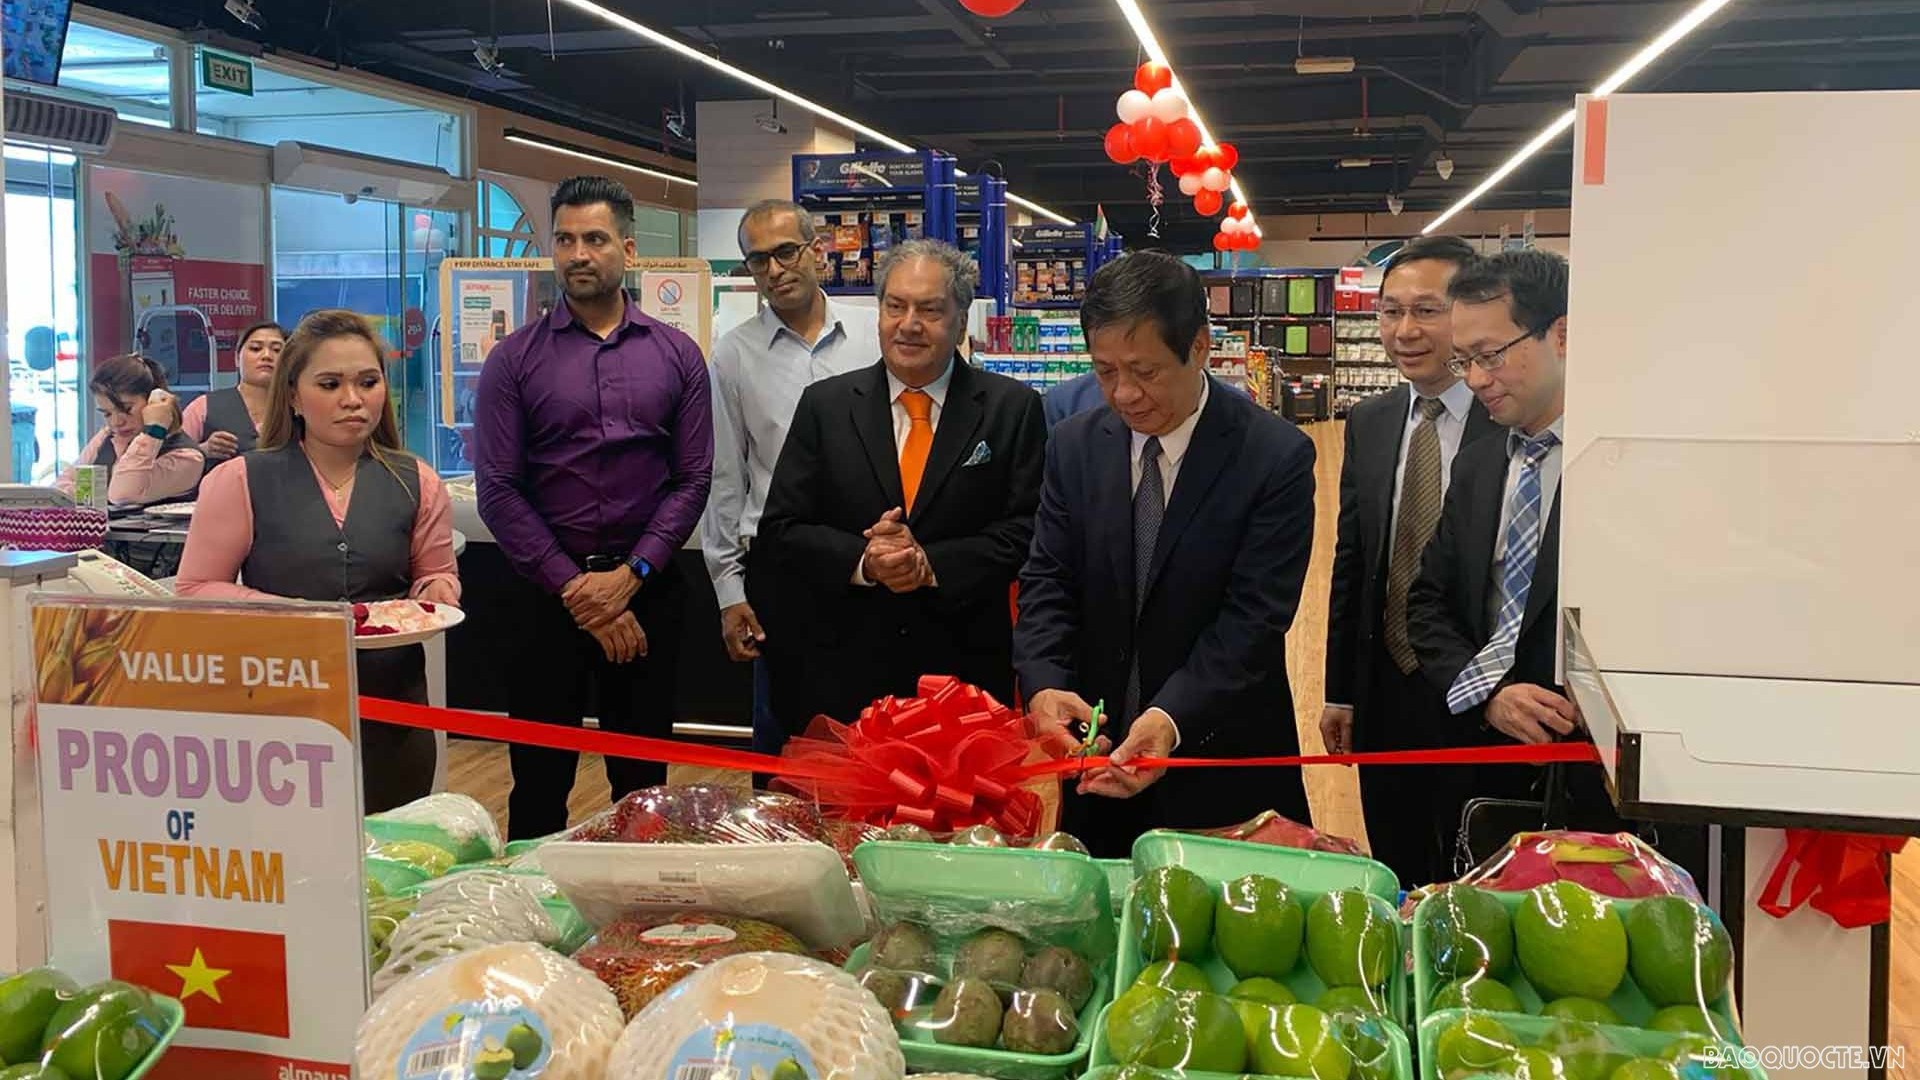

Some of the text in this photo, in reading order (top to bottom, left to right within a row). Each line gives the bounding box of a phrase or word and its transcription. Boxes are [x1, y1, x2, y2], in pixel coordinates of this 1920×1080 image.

[213, 63, 246, 83] EXIT
[188, 287, 219, 300] FASTER
[220, 304, 257, 316] DELIVERY
[119, 650, 330, 690] VALUE DEAL
[57, 728, 334, 808] PRODUCT
[167, 810, 195, 841] OF
[98, 838, 285, 904] VIETNAM
